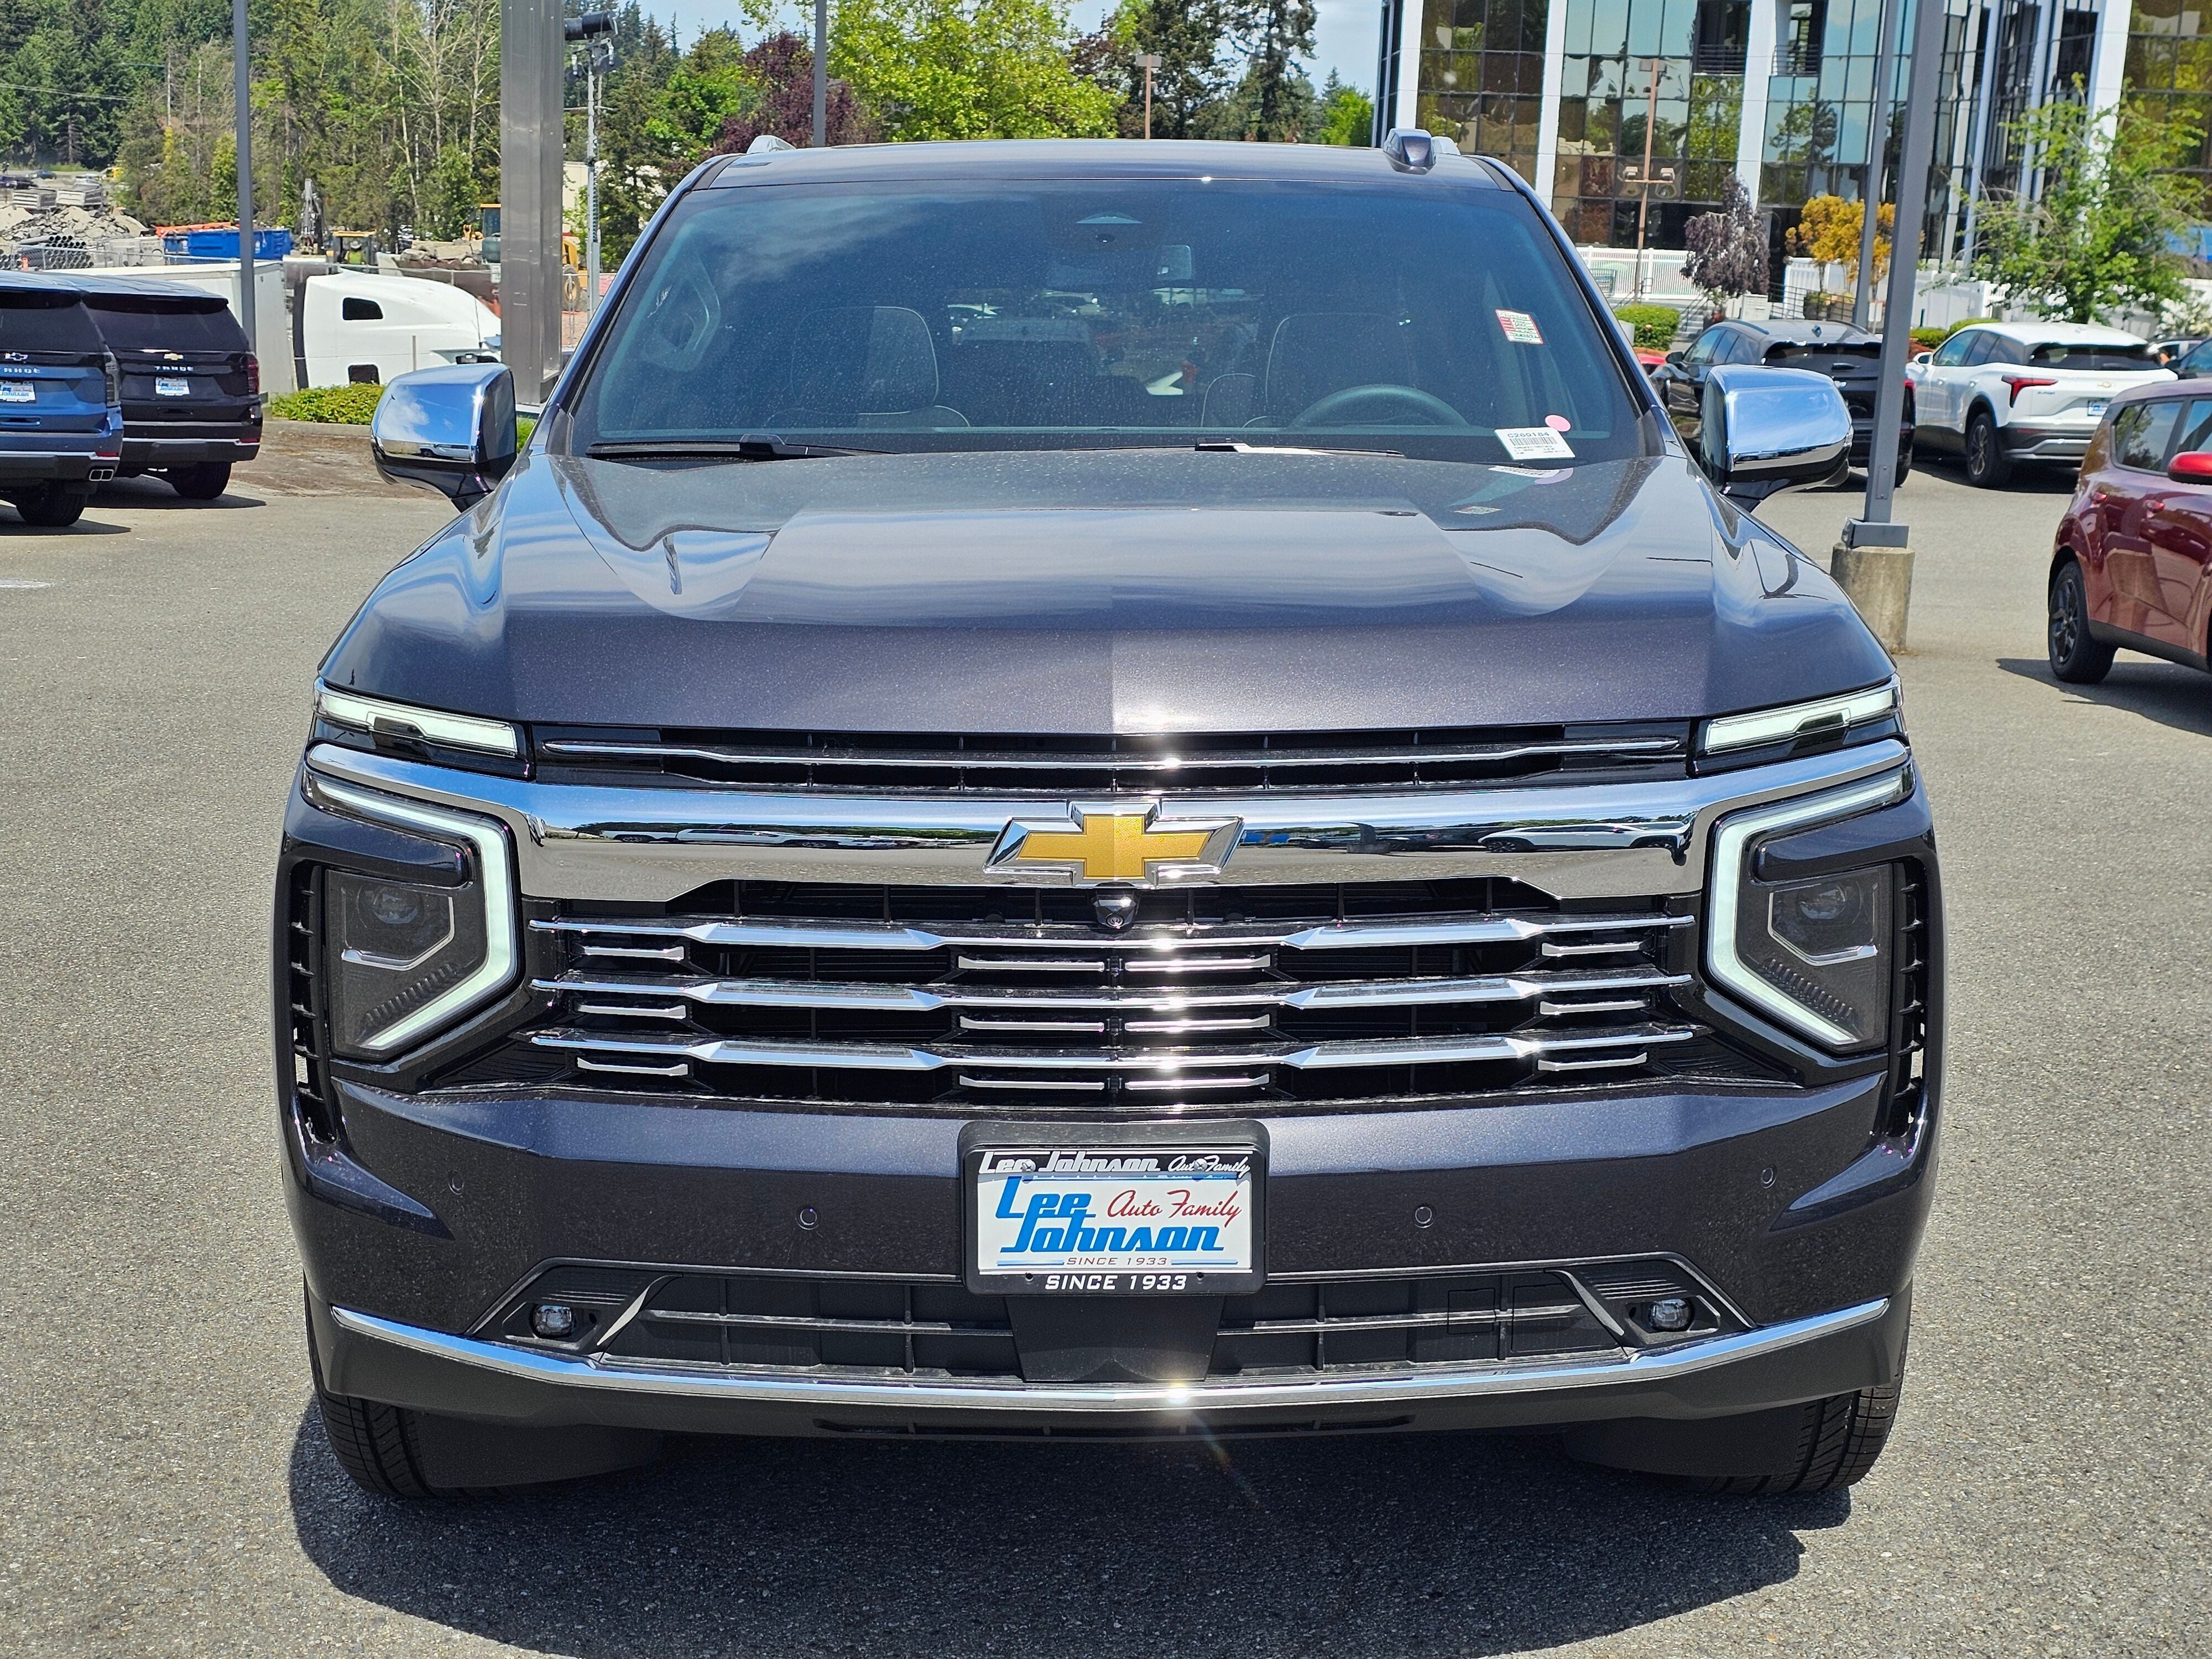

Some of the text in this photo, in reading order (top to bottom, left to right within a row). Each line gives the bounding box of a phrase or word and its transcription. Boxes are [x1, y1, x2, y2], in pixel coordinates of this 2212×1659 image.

[1038, 1150, 1161, 1172] Johnson
[1168, 1155, 1201, 1172] Aut
[1203, 1155, 1250, 1178] Family
[995, 1176, 1243, 1228] Lee Auto Family
[1000, 1210, 1224, 1253] Johnson
[1045, 1275, 1188, 1290] SINCE 1933
